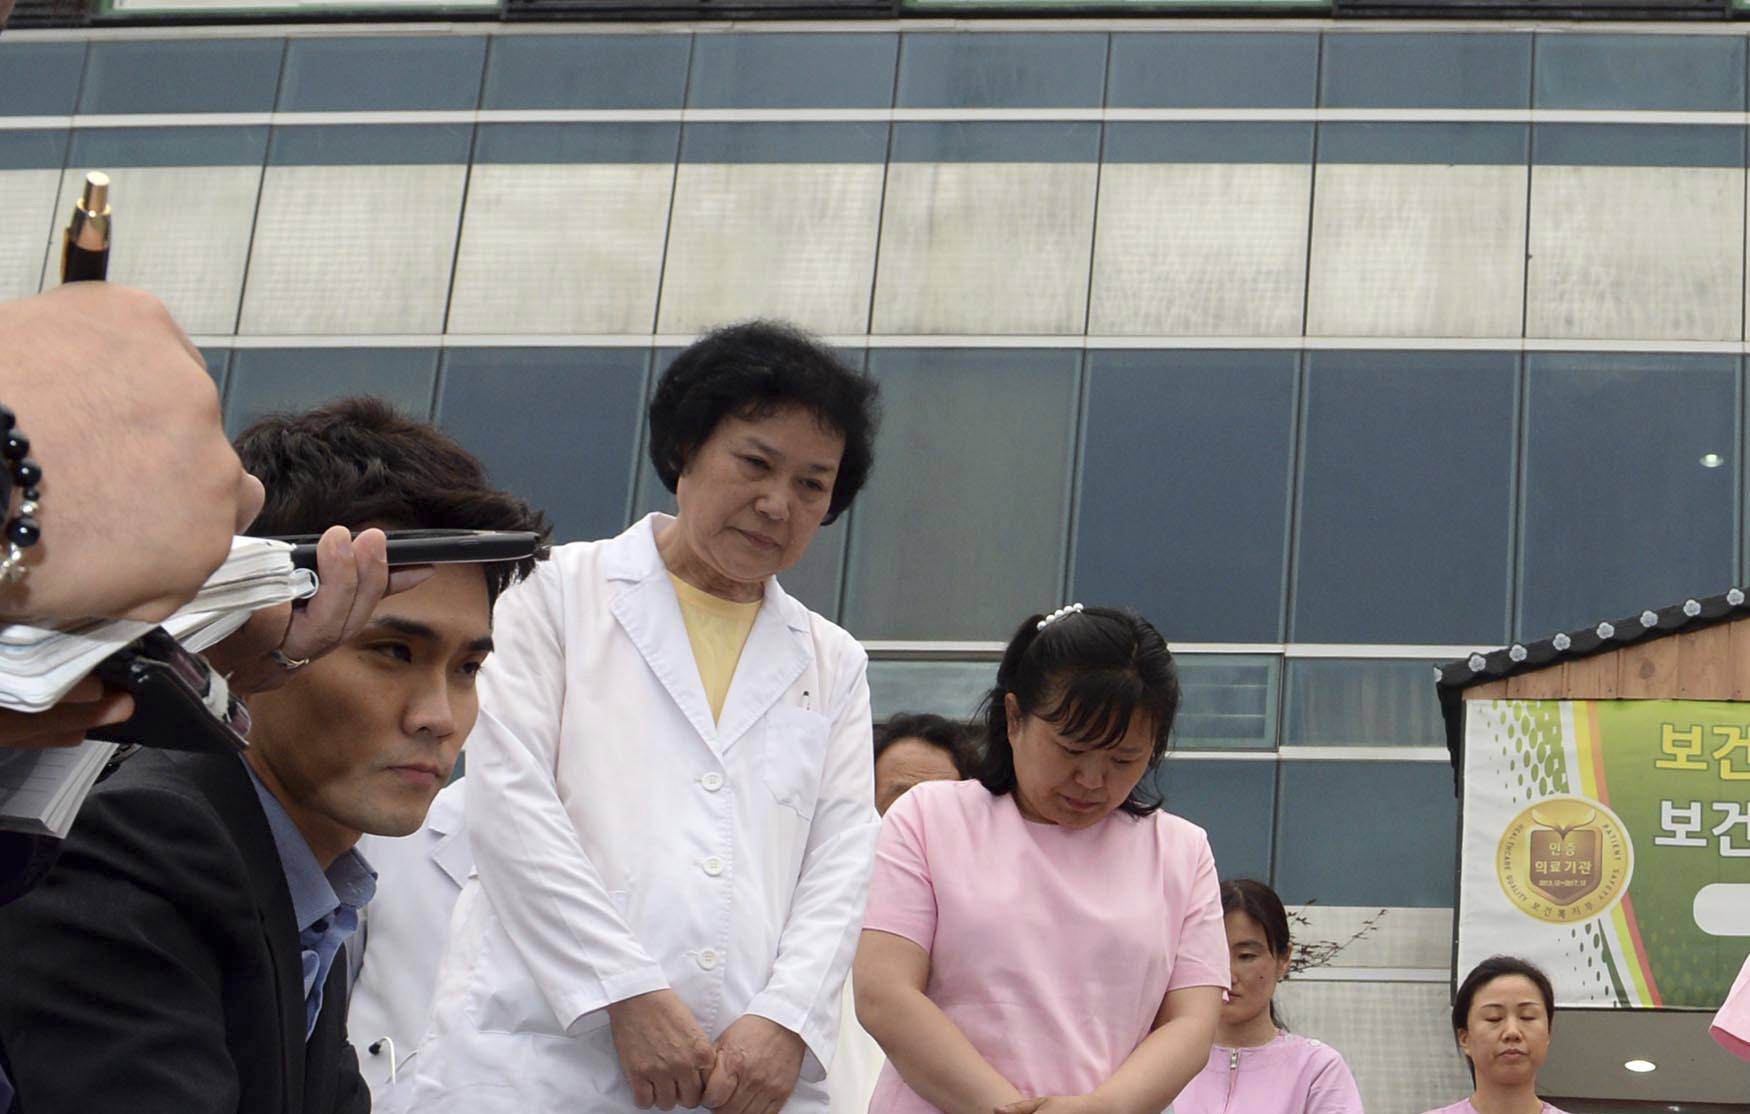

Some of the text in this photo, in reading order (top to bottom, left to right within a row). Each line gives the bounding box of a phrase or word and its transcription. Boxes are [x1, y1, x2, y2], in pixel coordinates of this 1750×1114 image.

[1535, 860, 1592, 875] 의료기관
[1599, 823, 1622, 900] PATIENT SAFETY
